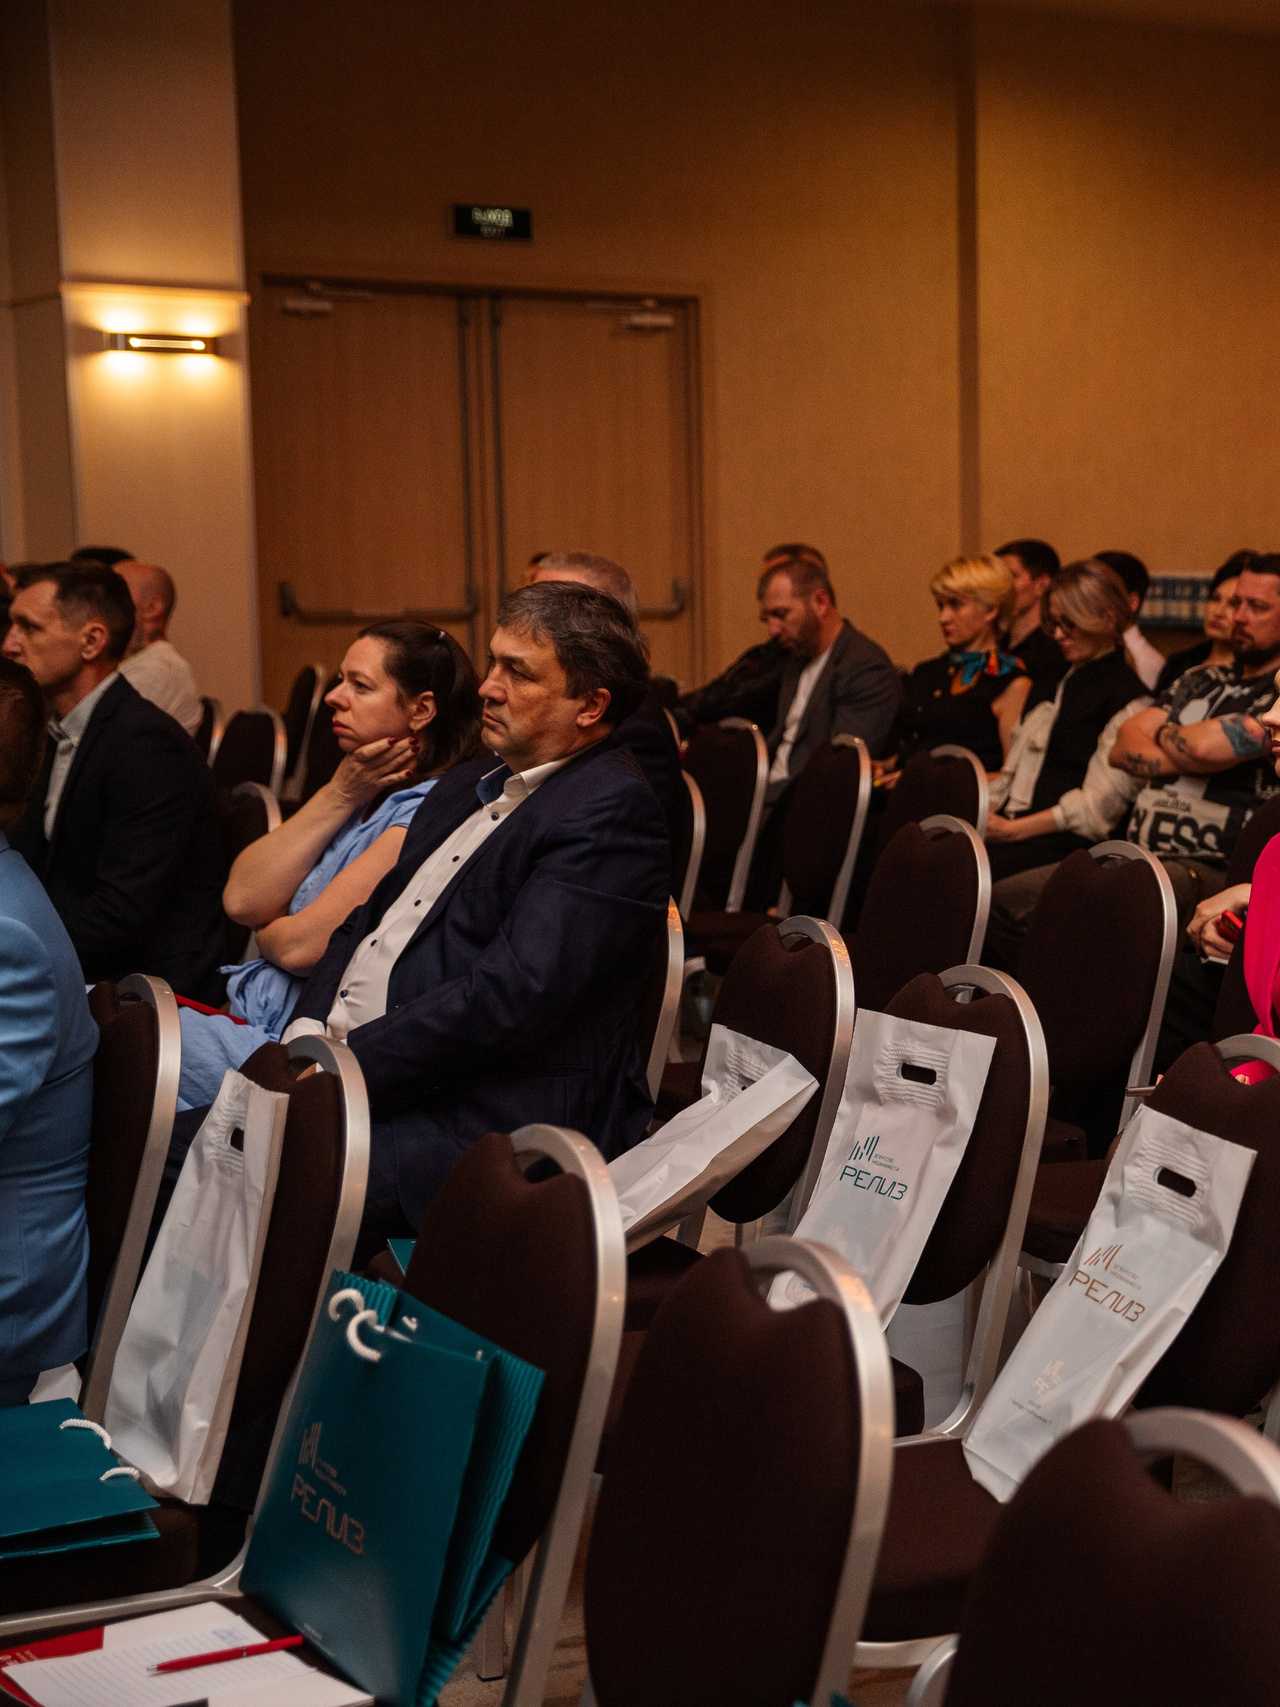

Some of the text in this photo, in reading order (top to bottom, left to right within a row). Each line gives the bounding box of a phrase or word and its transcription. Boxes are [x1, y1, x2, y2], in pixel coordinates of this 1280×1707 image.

[839, 1165, 908, 1201] РЕЛИЗ
[1068, 1269, 1146, 1322] РЕЛИЗ
[291, 1473, 365, 1555] РЕЛИЗ
